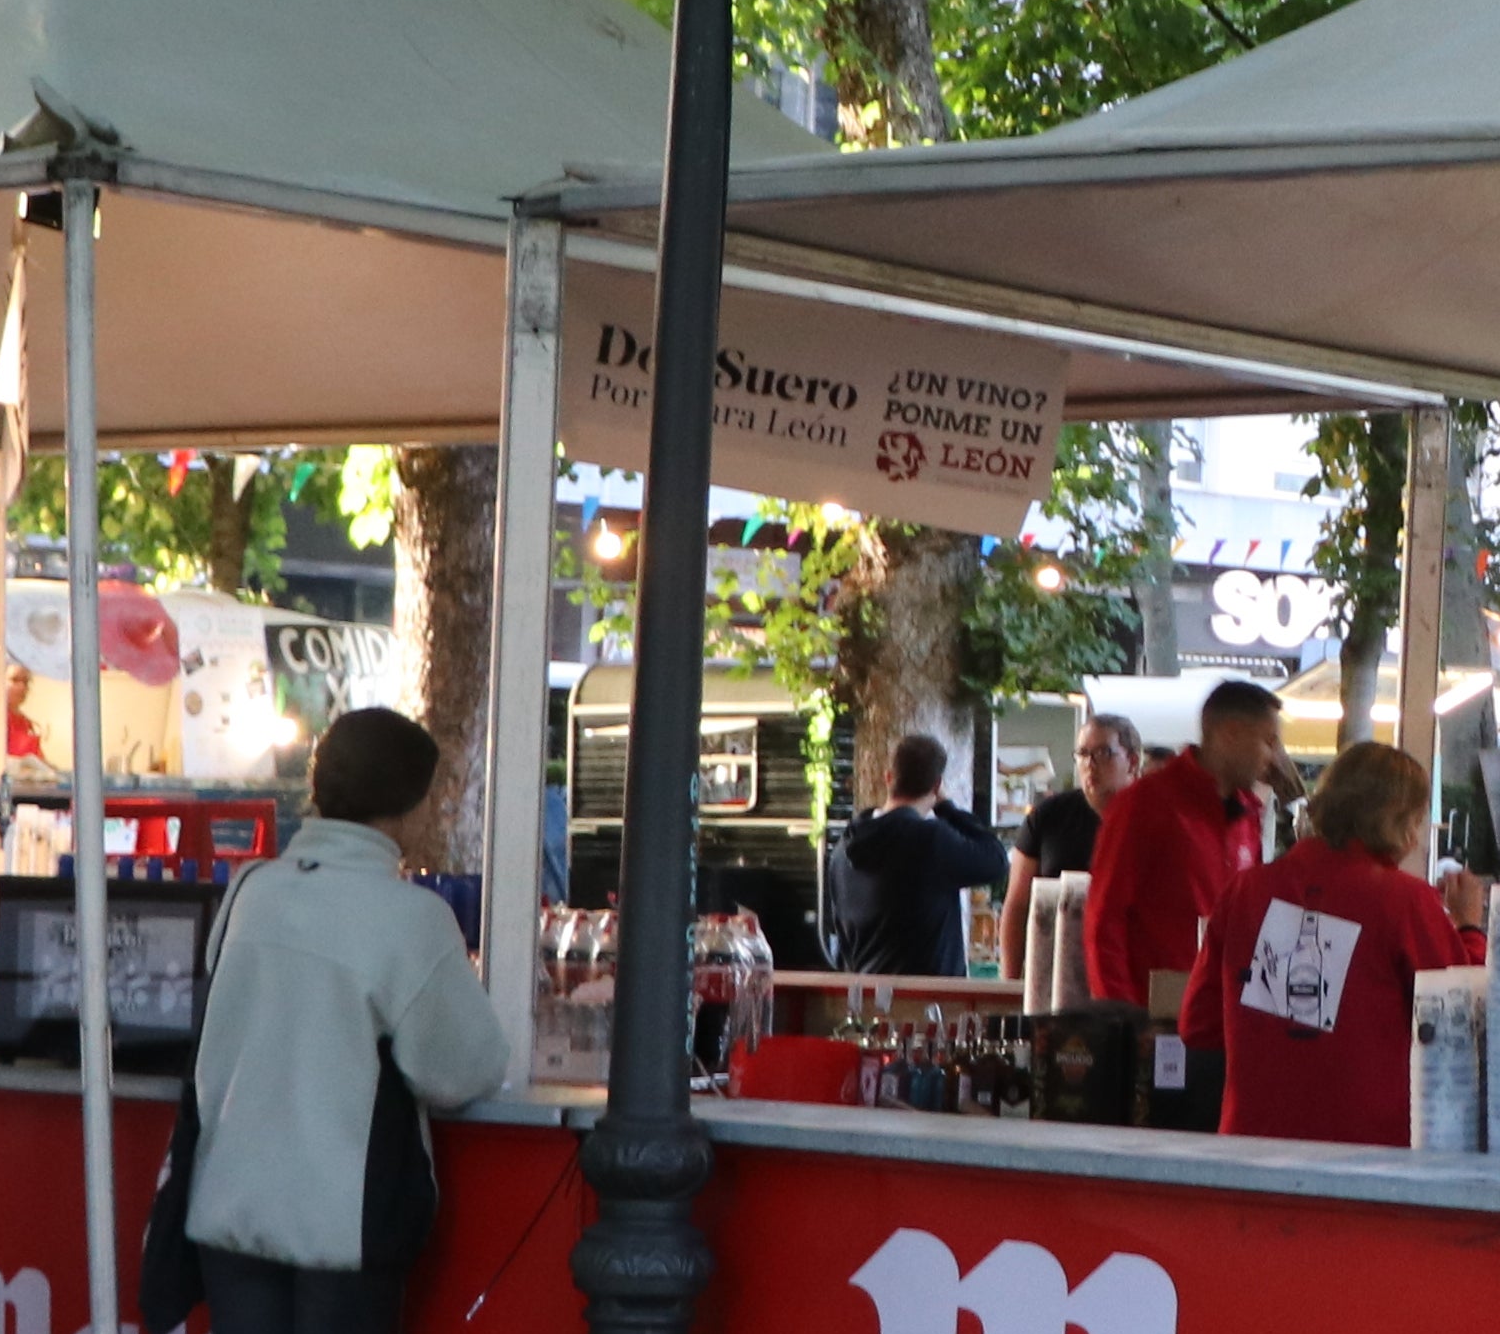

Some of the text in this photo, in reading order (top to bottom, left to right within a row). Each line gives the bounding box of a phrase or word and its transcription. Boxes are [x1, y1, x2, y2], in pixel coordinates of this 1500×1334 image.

[714, 346, 858, 412] Suero
[887, 368, 1048, 414] ¿UN VINO?
[767, 407, 848, 447] León
[882, 397, 1043, 446] PONME UN
[939, 442, 1036, 480] LEÓN
[278, 626, 393, 677] COMID
